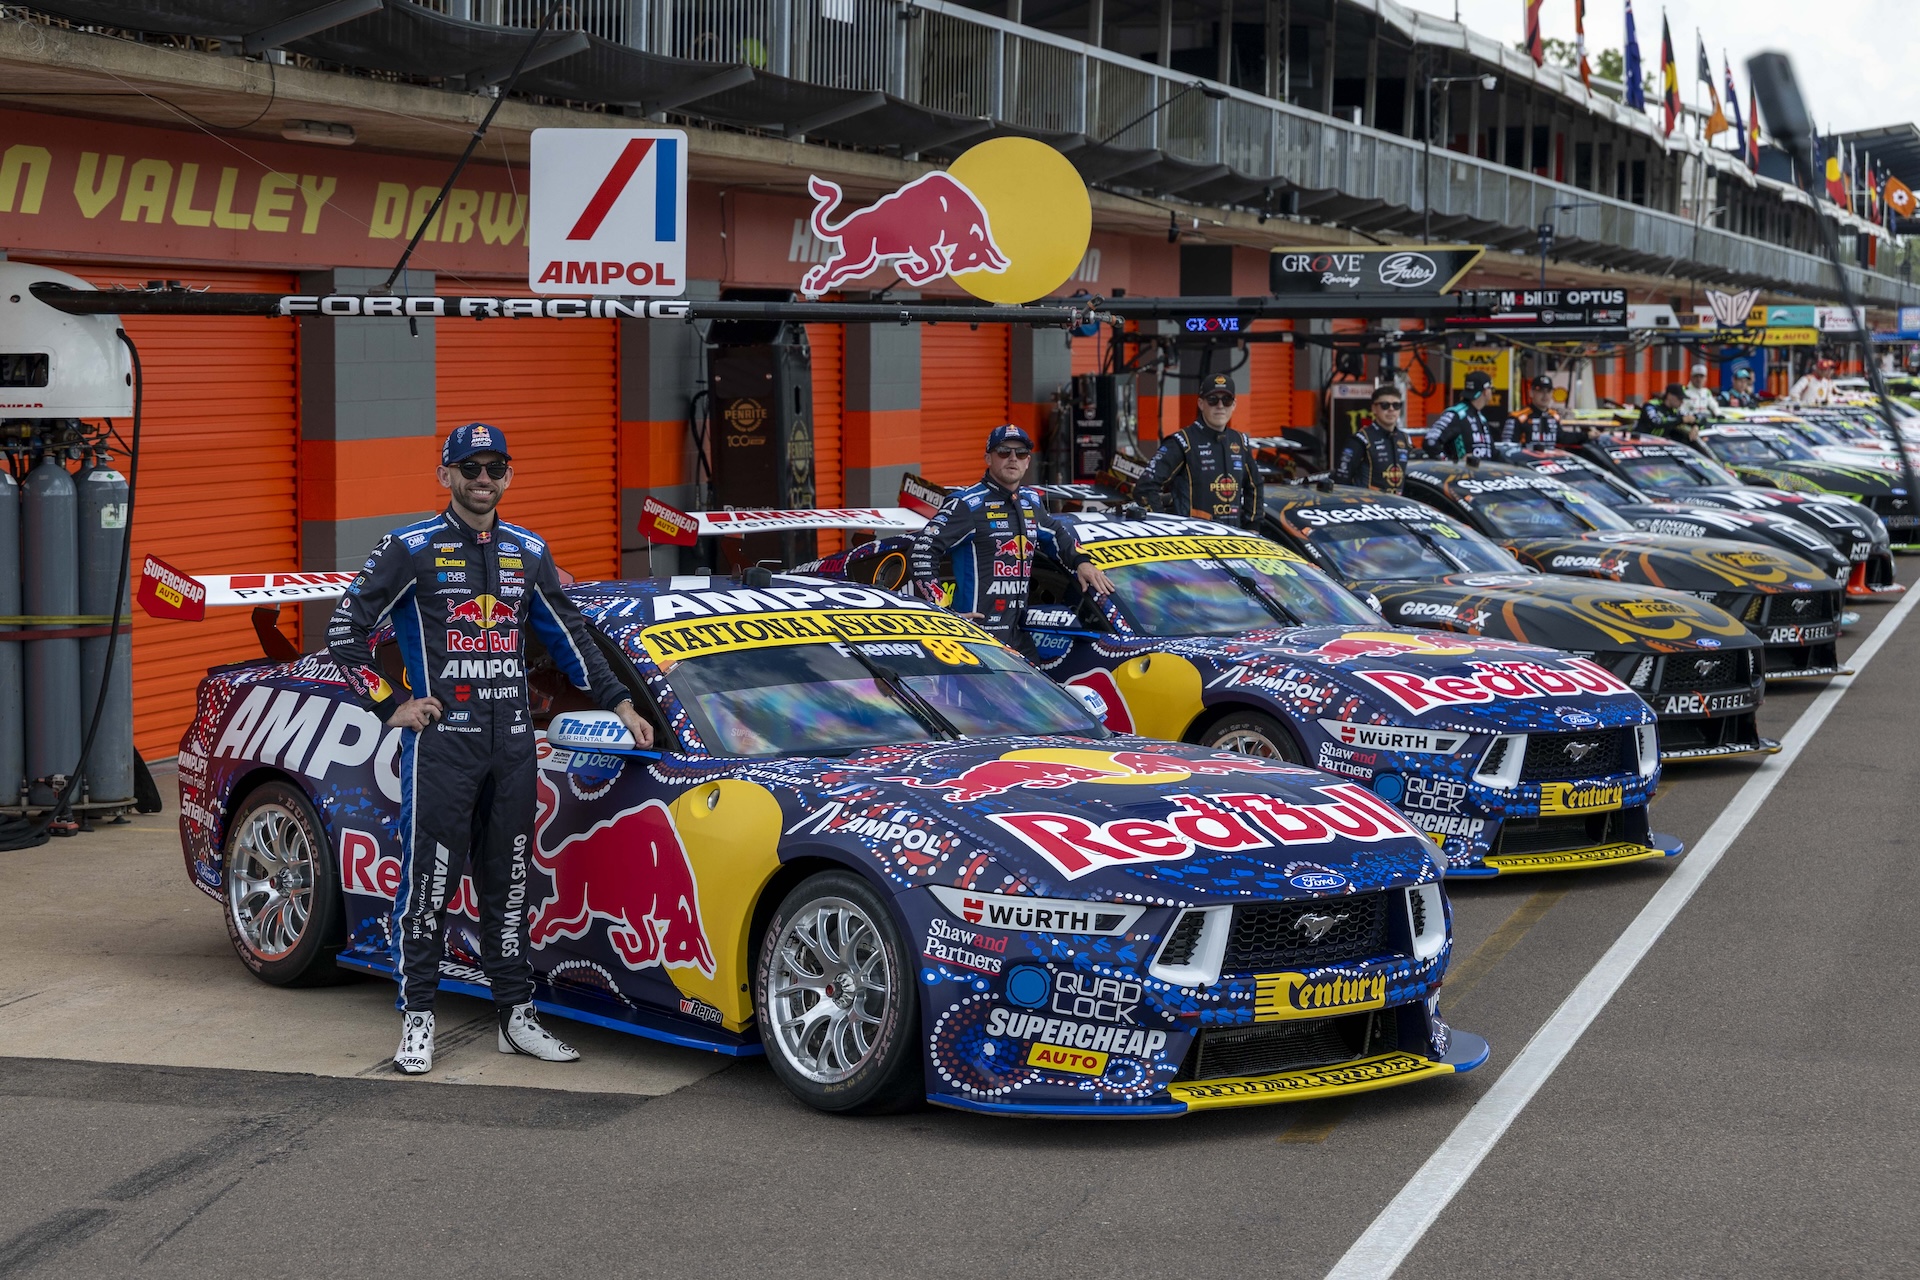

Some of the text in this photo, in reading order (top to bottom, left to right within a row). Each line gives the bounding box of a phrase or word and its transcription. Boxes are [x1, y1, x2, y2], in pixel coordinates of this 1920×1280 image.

[73, 151, 531, 247] VALLEY DARW
[538, 261, 676, 286] AMPOL
[1282, 254, 1361, 273] GROVE
[1387, 254, 1433, 280] Gates
[1320, 272, 1361, 287] Racing
[280, 296, 691, 320] FORD RACING
[1501, 291, 1542, 306] Mobil
[1566, 290, 1624, 305] OPTUS
[1186, 318, 1239, 332] GROVE
[724, 409, 768, 420] PENRITE
[1408, 470, 1442, 486] ALLEN
[644, 498, 698, 533] SUPERCHEAP
[656, 519, 676, 533] AUTO
[712, 517, 905, 530] Premium Fuels
[735, 509, 886, 521] AMPLIFY
[1297, 504, 1424, 526] Steadfast
[1650, 518, 1706, 534] RINGERS
[408, 535, 426, 546] OMP
[1074, 520, 1260, 542] AMPOL
[1429, 522, 1461, 540] 19
[1088, 541, 1201, 565] NATIONAL
[994, 561, 1020, 577] Red
[1248, 558, 1299, 577] 888
[143, 557, 205, 604] SUPERCHEAP
[158, 586, 181, 605] AUTO
[652, 587, 933, 622] AMPOL
[1026, 609, 1077, 627] Thrifty
[330, 638, 355, 648] Suttons
[446, 628, 519, 653] Red Bull
[645, 613, 987, 656] NATIONAL STORAGE
[1041, 633, 1070, 650] betr
[1804, 626, 1829, 640] STEEL
[921, 638, 981, 667] 88
[440, 658, 523, 679] AMPOL
[1248, 675, 1326, 703] AMPOL
[1350, 659, 1549, 717] Red
[1498, 657, 1639, 698] Bull
[1664, 692, 1745, 716] APEX STEEL
[558, 718, 627, 742] Thrifty
[1360, 729, 1429, 749] WÜRTH
[589, 753, 620, 769] betr
[1319, 741, 1377, 765] Shaw and
[745, 768, 812, 787] DUNLOP
[1317, 753, 1374, 779] Partners
[1407, 776, 1467, 799] QUAD
[1549, 783, 1623, 810] Century
[1404, 791, 1464, 813] LOCK
[841, 817, 942, 857] AMPOL
[985, 783, 1430, 882] Red Bull
[506, 882, 526, 910] YOU
[988, 904, 1090, 931] WÜRTH
[928, 917, 1009, 953] Shaw and
[923, 935, 1003, 974] Partners
[757, 914, 783, 1025] DUNLOP
[1055, 971, 1143, 1004] QUAD
[1268, 972, 1388, 1012] Century
[689, 1003, 723, 1023] Repco
[1051, 992, 1138, 1025] LOCK
[985, 1007, 1167, 1059] SUPERCHEAP
[1036, 1049, 1099, 1070] AUTO
